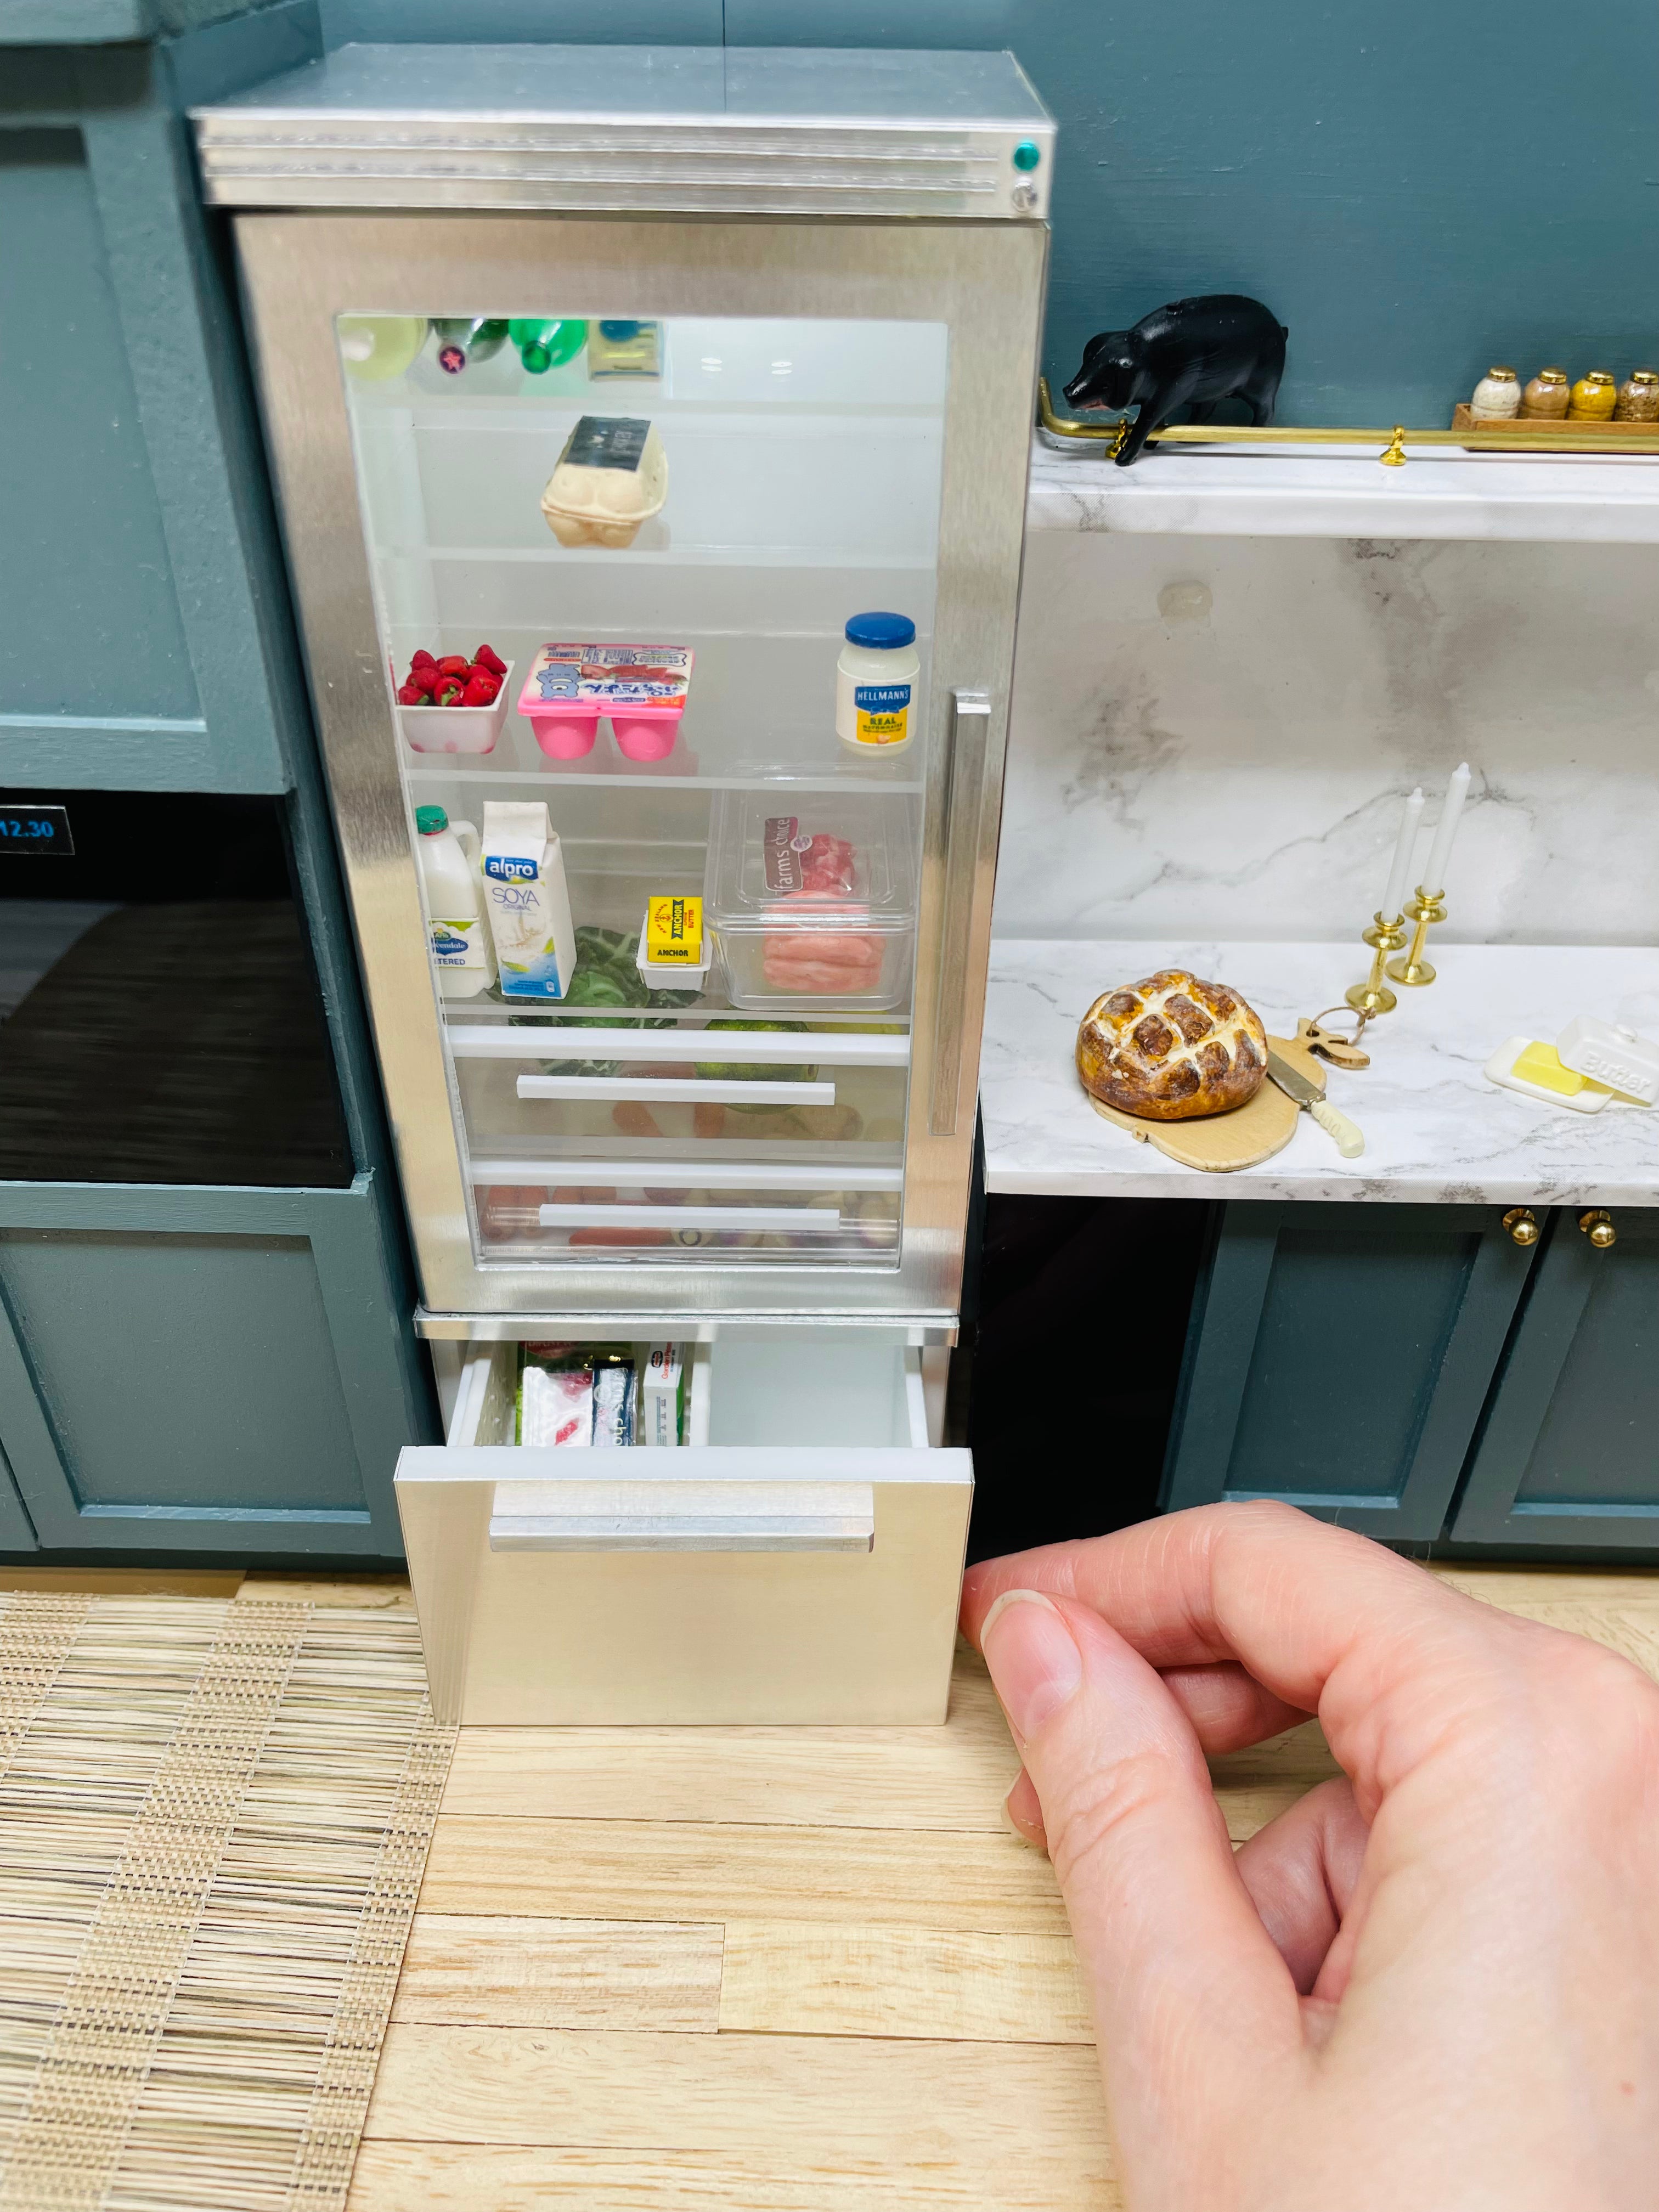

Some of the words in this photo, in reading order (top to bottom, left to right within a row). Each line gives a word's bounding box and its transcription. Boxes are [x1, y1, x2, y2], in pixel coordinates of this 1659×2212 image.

[858, 687, 909, 701] HELLMANN'S
[870, 716, 896, 725] REAL
[771, 819, 791, 845] choice
[489, 858, 534, 878] alpro
[774, 850, 793, 889] farms
[492, 887, 540, 906] SOYA
[673, 904, 682, 935] ANCHOR
[1581, 1051, 1651, 1093] Butter
[661, 1357, 670, 1379] Garden
